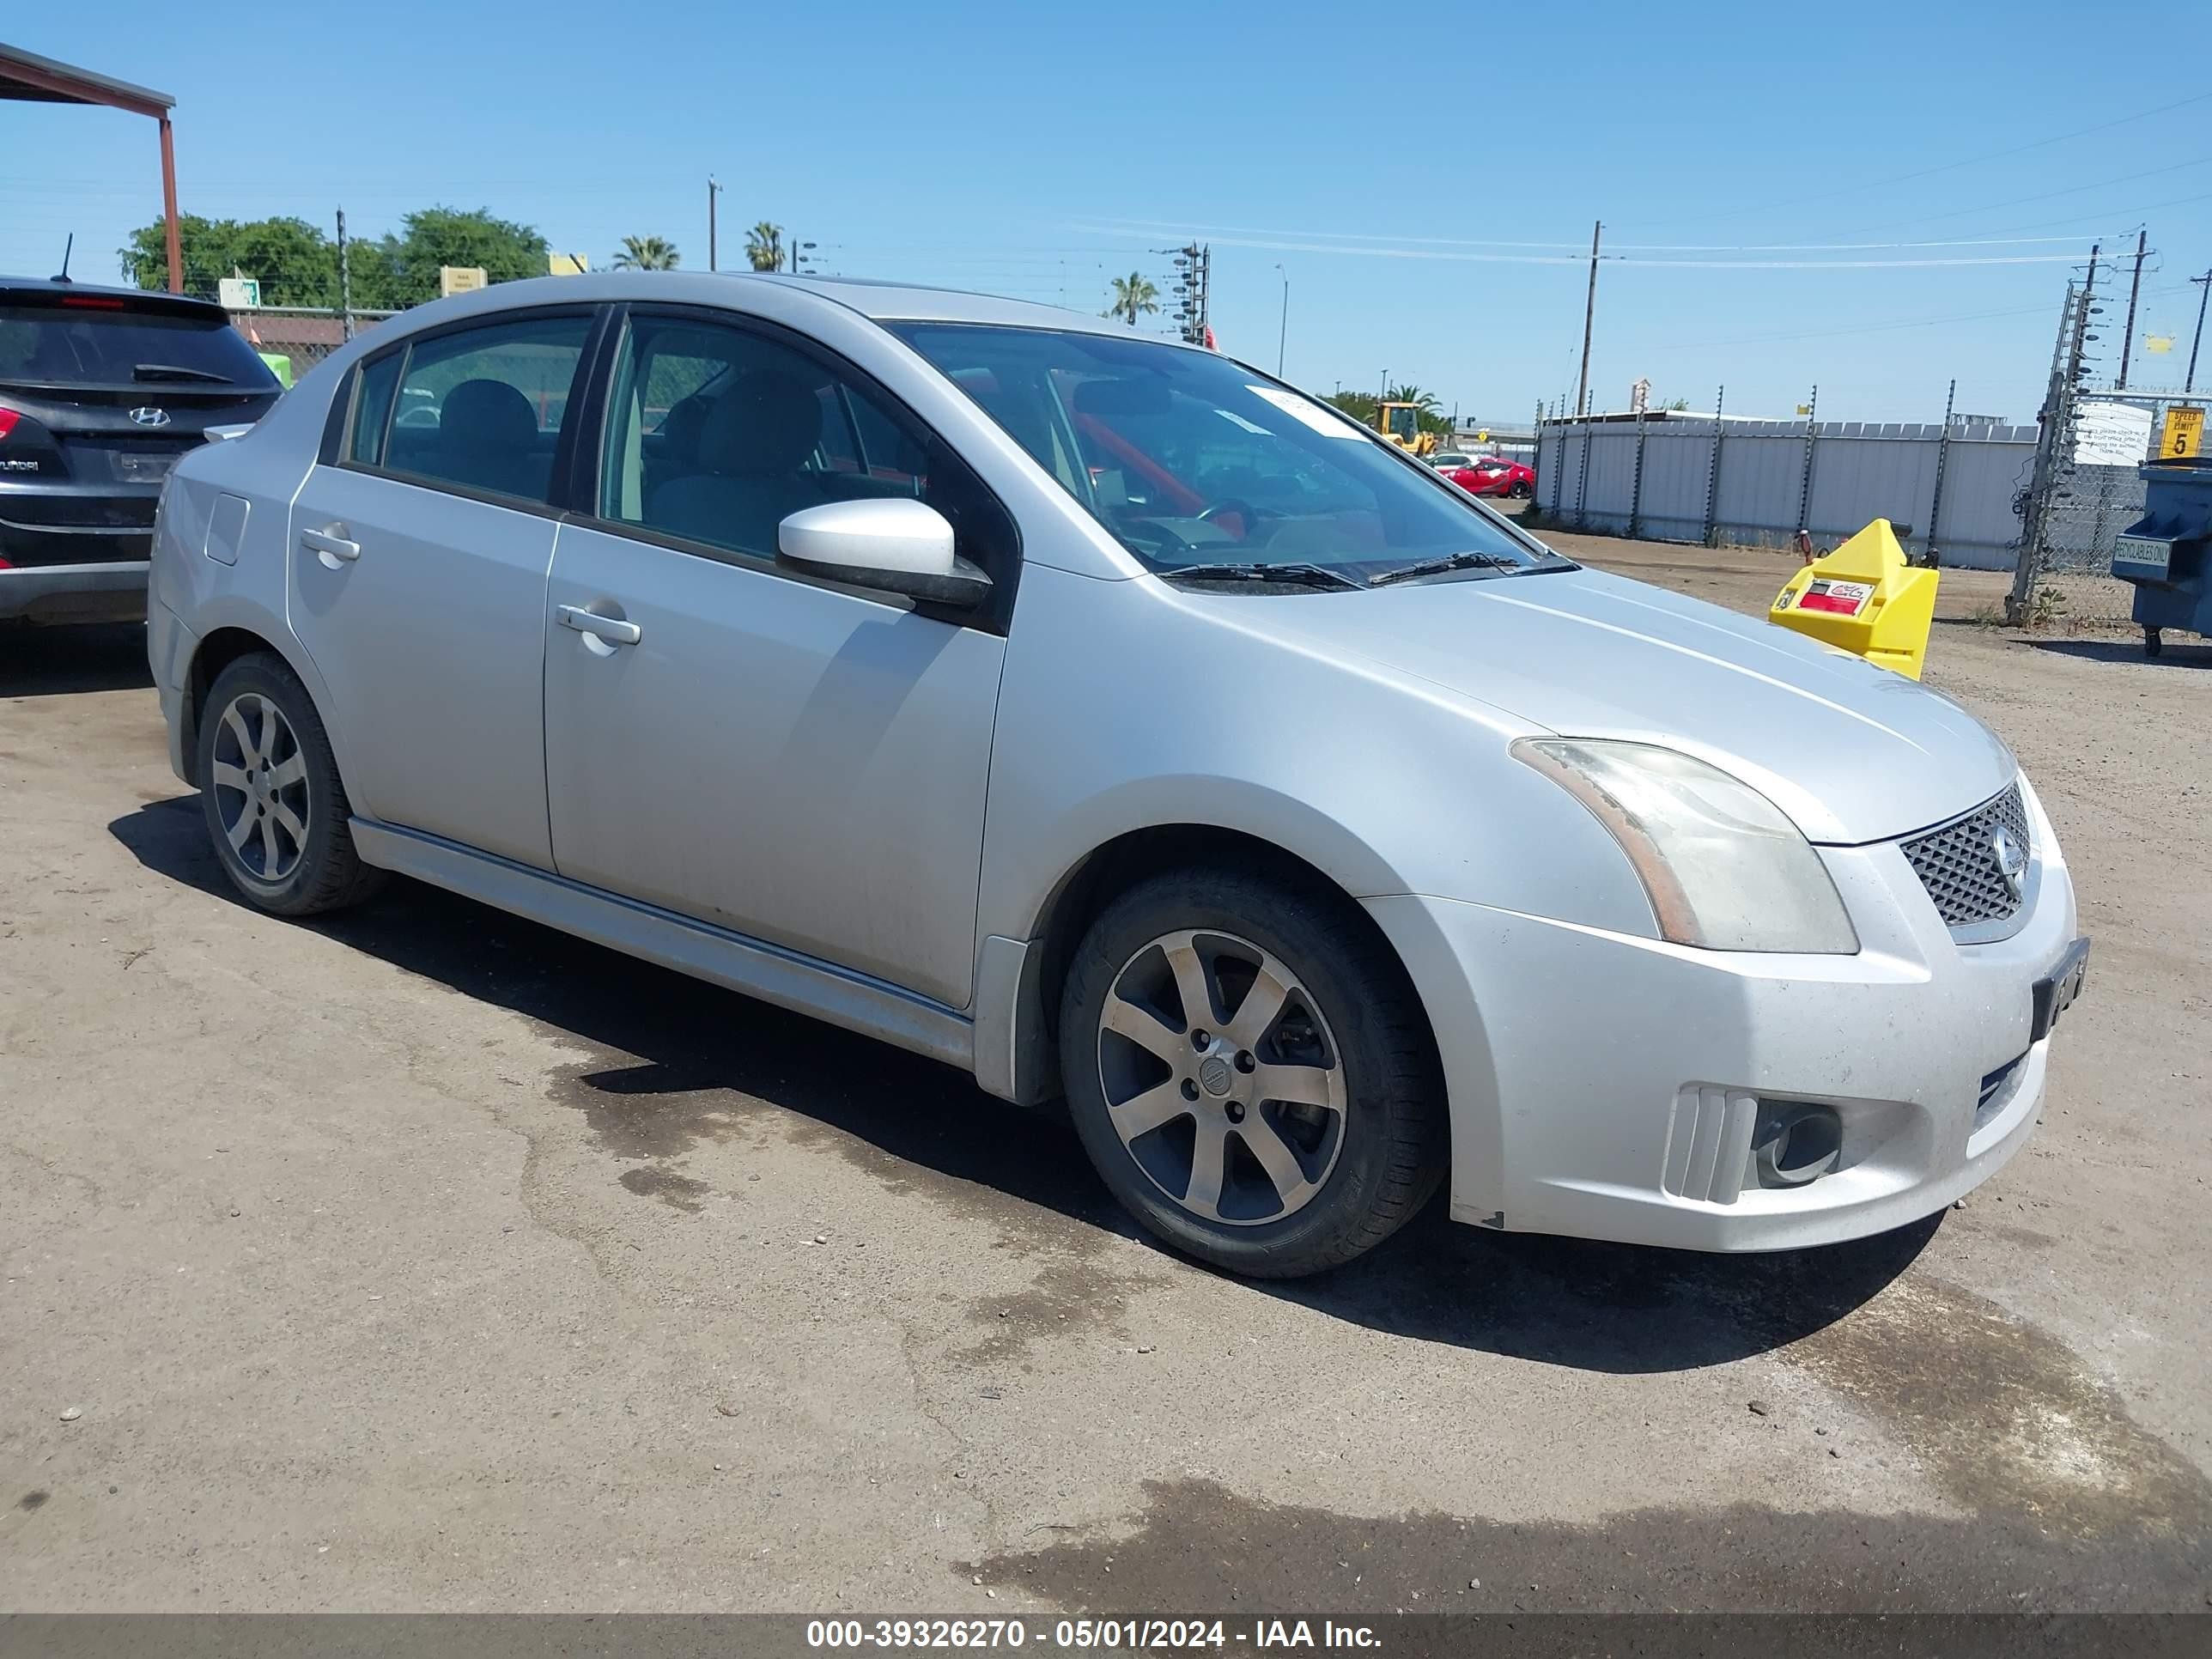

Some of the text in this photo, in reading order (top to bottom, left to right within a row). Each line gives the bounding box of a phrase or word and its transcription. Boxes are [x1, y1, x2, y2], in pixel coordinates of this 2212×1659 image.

[2174, 411, 2197, 421] SPEED
[2173, 422, 2193, 431] LIMIT
[2173, 433, 2187, 454] 5
